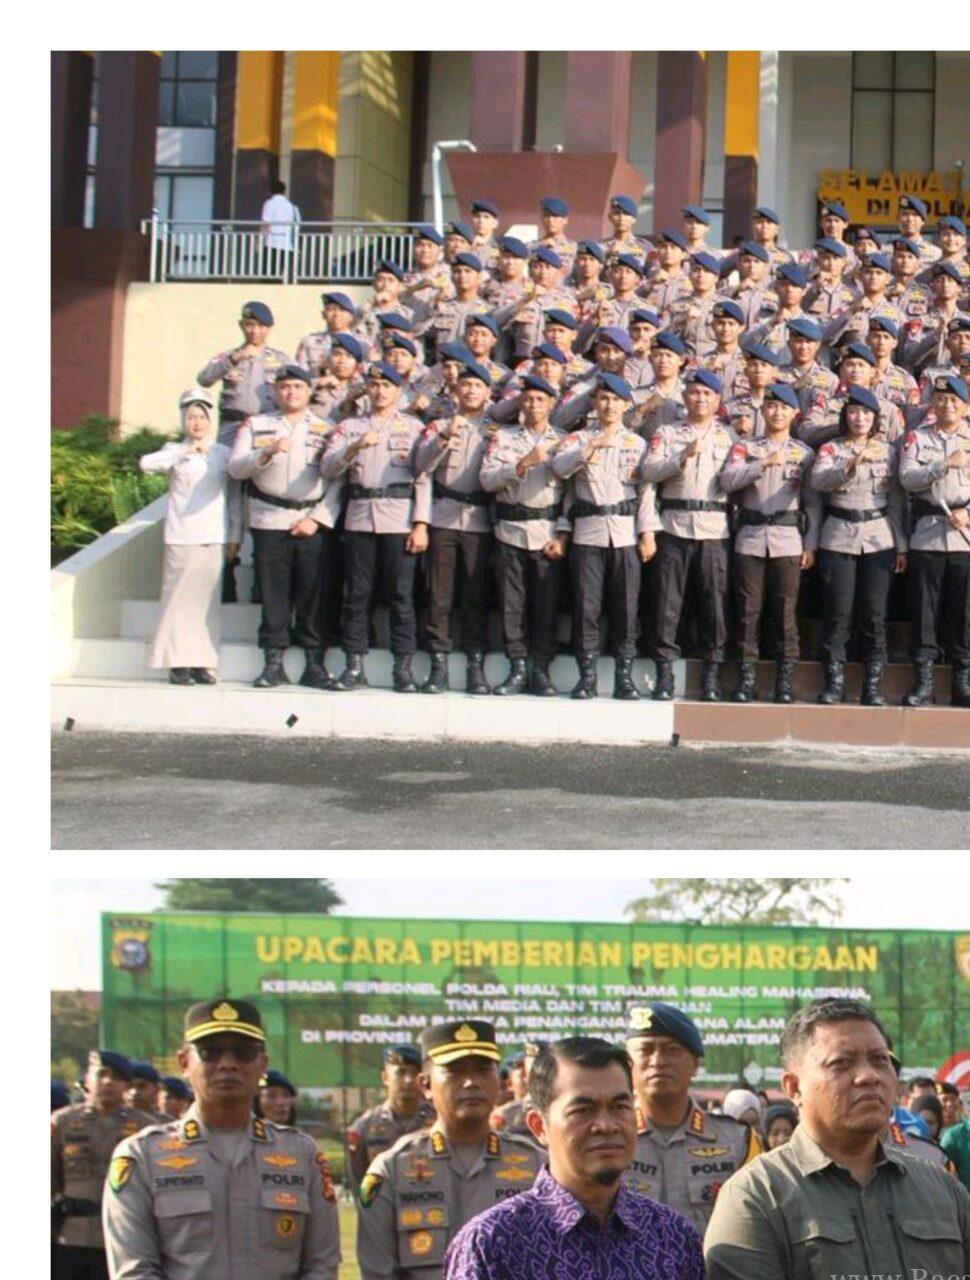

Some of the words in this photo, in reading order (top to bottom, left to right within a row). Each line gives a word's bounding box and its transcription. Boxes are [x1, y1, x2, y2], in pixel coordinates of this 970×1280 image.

[819, 169, 964, 192] SELAMAT
[866, 198, 890, 216] DI
[256, 935, 423, 965] UPACARA
[430, 938, 622, 968] PEMBERIAN
[632, 941, 878, 972] PENGHARGAAN
[262, 980, 337, 993] KEPADA
[447, 984, 508, 995] POLDA
[568, 985, 597, 996] TIM
[603, 985, 678, 997] TRAUMA
[685, 986, 758, 998] HEALING
[445, 1000, 478, 1012] TIM
[483, 1001, 540, 1012] MEDIA
[547, 1001, 584, 1012] DAN
[592, 1002, 621, 1013] TIM
[359, 1014, 427, 1027] DALAM
[735, 1018, 786, 1030] ALAM
[301, 1031, 321, 1043] DI
[325, 1031, 412, 1044] PROVINSI
[691, 1162, 735, 1175] POLRI
[262, 1173, 305, 1186] POLRI
